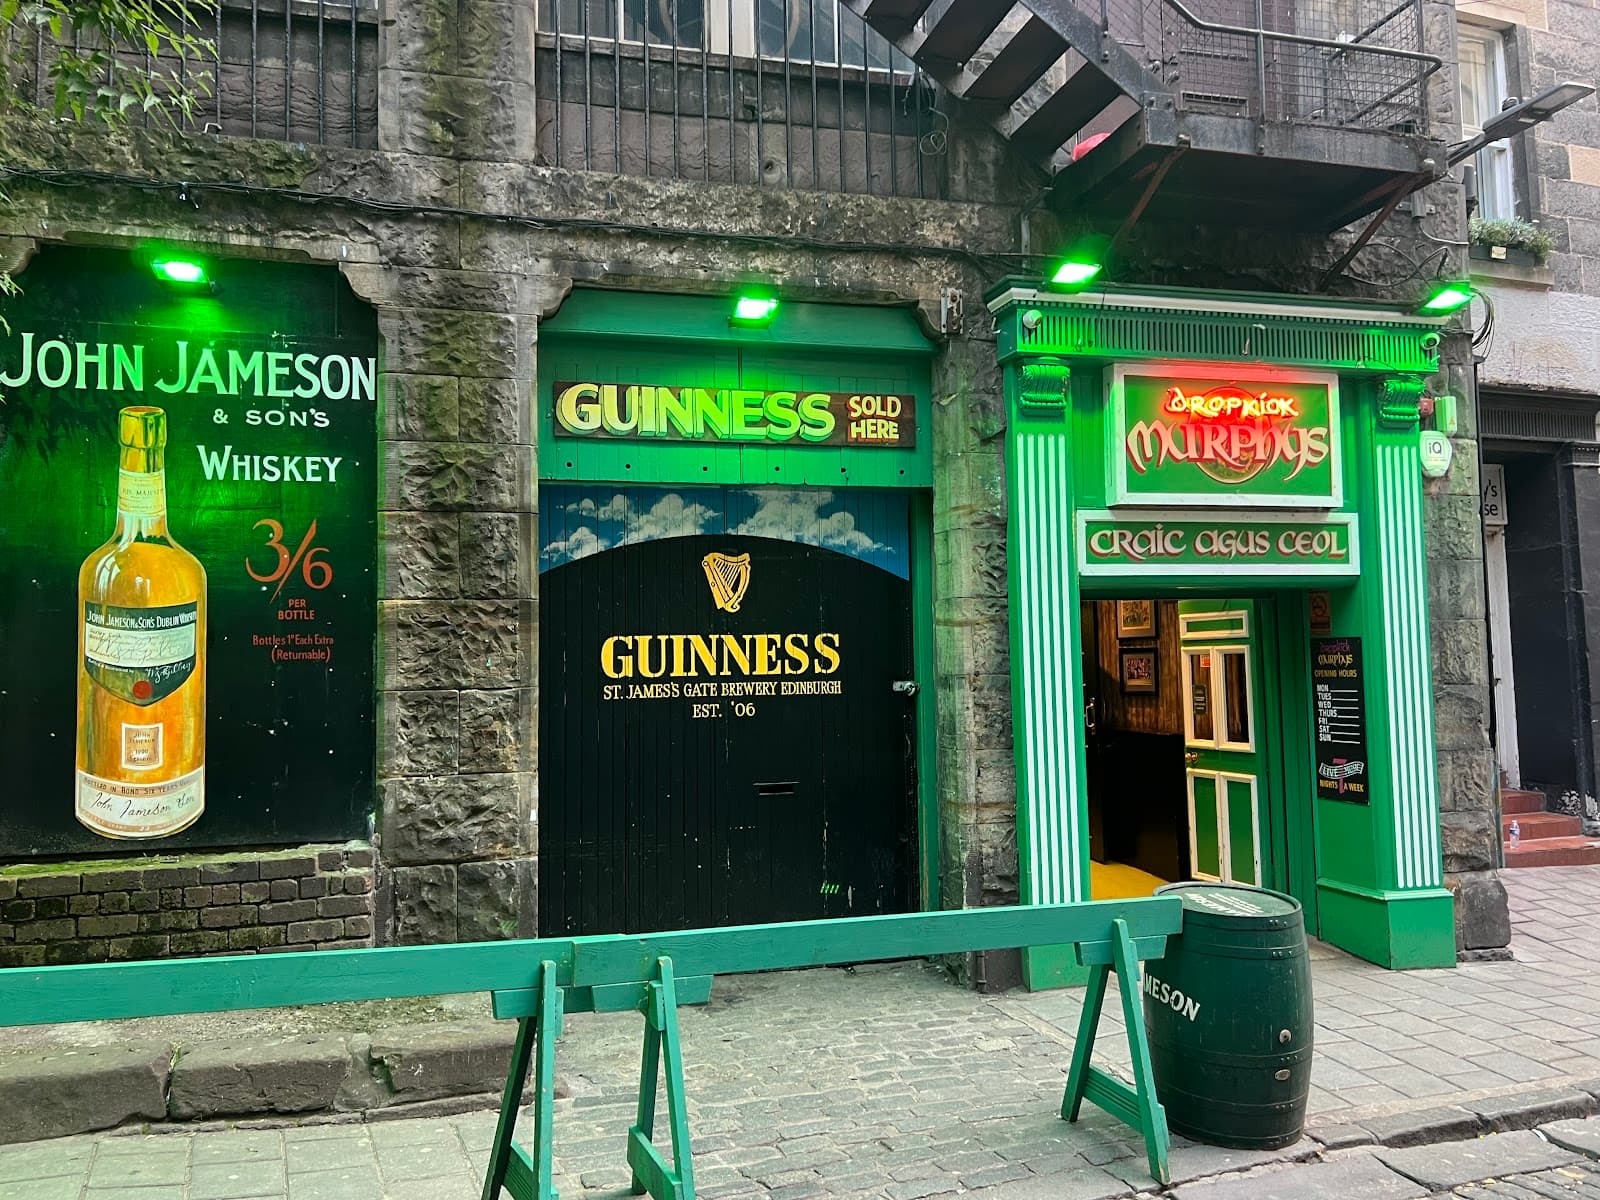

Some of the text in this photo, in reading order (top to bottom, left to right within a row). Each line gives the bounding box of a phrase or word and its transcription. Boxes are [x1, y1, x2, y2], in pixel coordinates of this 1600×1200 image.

[0, 332, 377, 401] JOHN JAMESON
[556, 382, 837, 442] GUINNESS
[847, 394, 902, 419] SOLD
[212, 407, 331, 428] & SON'S
[847, 418, 900, 442] HERE
[196, 445, 342, 483] WHISKEY
[245, 518, 333, 604] 3/6
[288, 599, 306, 608] PER
[278, 610, 315, 620] BOTTLE
[252, 634, 286, 646] Bottles
[295, 634, 313, 645] Each
[314, 634, 334, 645] Extra
[271, 647, 331, 664] (Returnable)
[600, 632, 841, 679] GUINNESS
[1338, 670, 1358, 678] HOURS
[603, 685, 624, 700] ST.
[684, 683, 718, 697] GATE
[721, 681, 777, 697] BREWERY
[781, 680, 842, 696] EDINBURGH
[1316, 684, 1329, 692] MON
[1317, 692, 1332, 700] TUES
[692, 704, 723, 718] EST.
[1318, 701, 1332, 709] WED
[1318, 709, 1338, 718] THURS
[1318, 717, 1328, 725] FRI
[1319, 725, 1330, 733] SAT
[1319, 733, 1332, 742] SUN
[1348, 782, 1364, 793] WEEK
